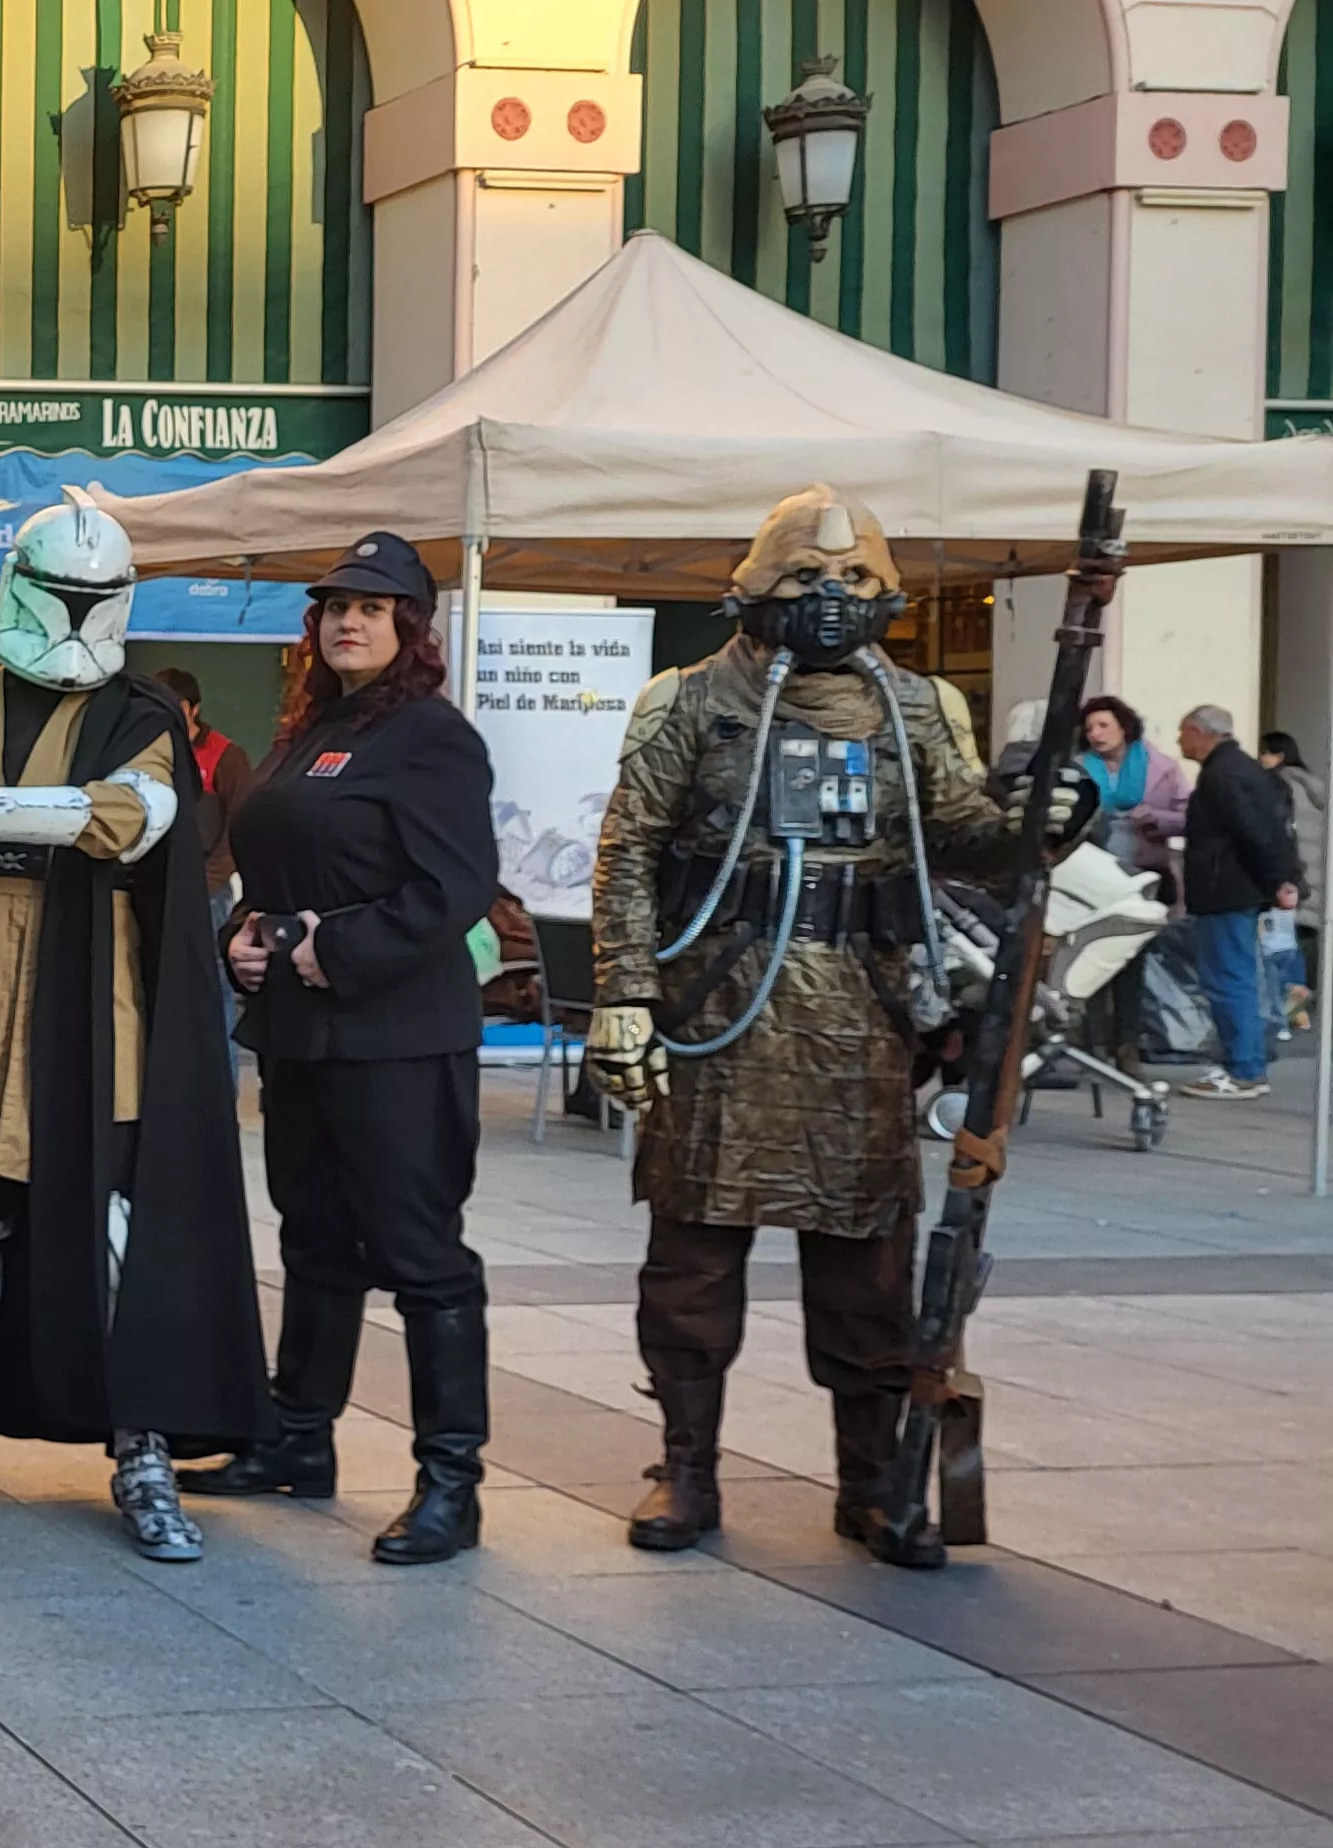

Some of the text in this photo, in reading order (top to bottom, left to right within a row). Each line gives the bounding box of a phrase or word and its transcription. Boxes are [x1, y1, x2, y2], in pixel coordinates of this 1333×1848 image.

[101, 398, 134, 448] LA
[141, 399, 278, 450] CONFIANZA
[568, 639, 587, 656] la
[590, 639, 631, 657] vida
[477, 670, 498, 684] un
[548, 671, 581, 684] con
[477, 692, 510, 711] Piel
[516, 693, 537, 711] de
